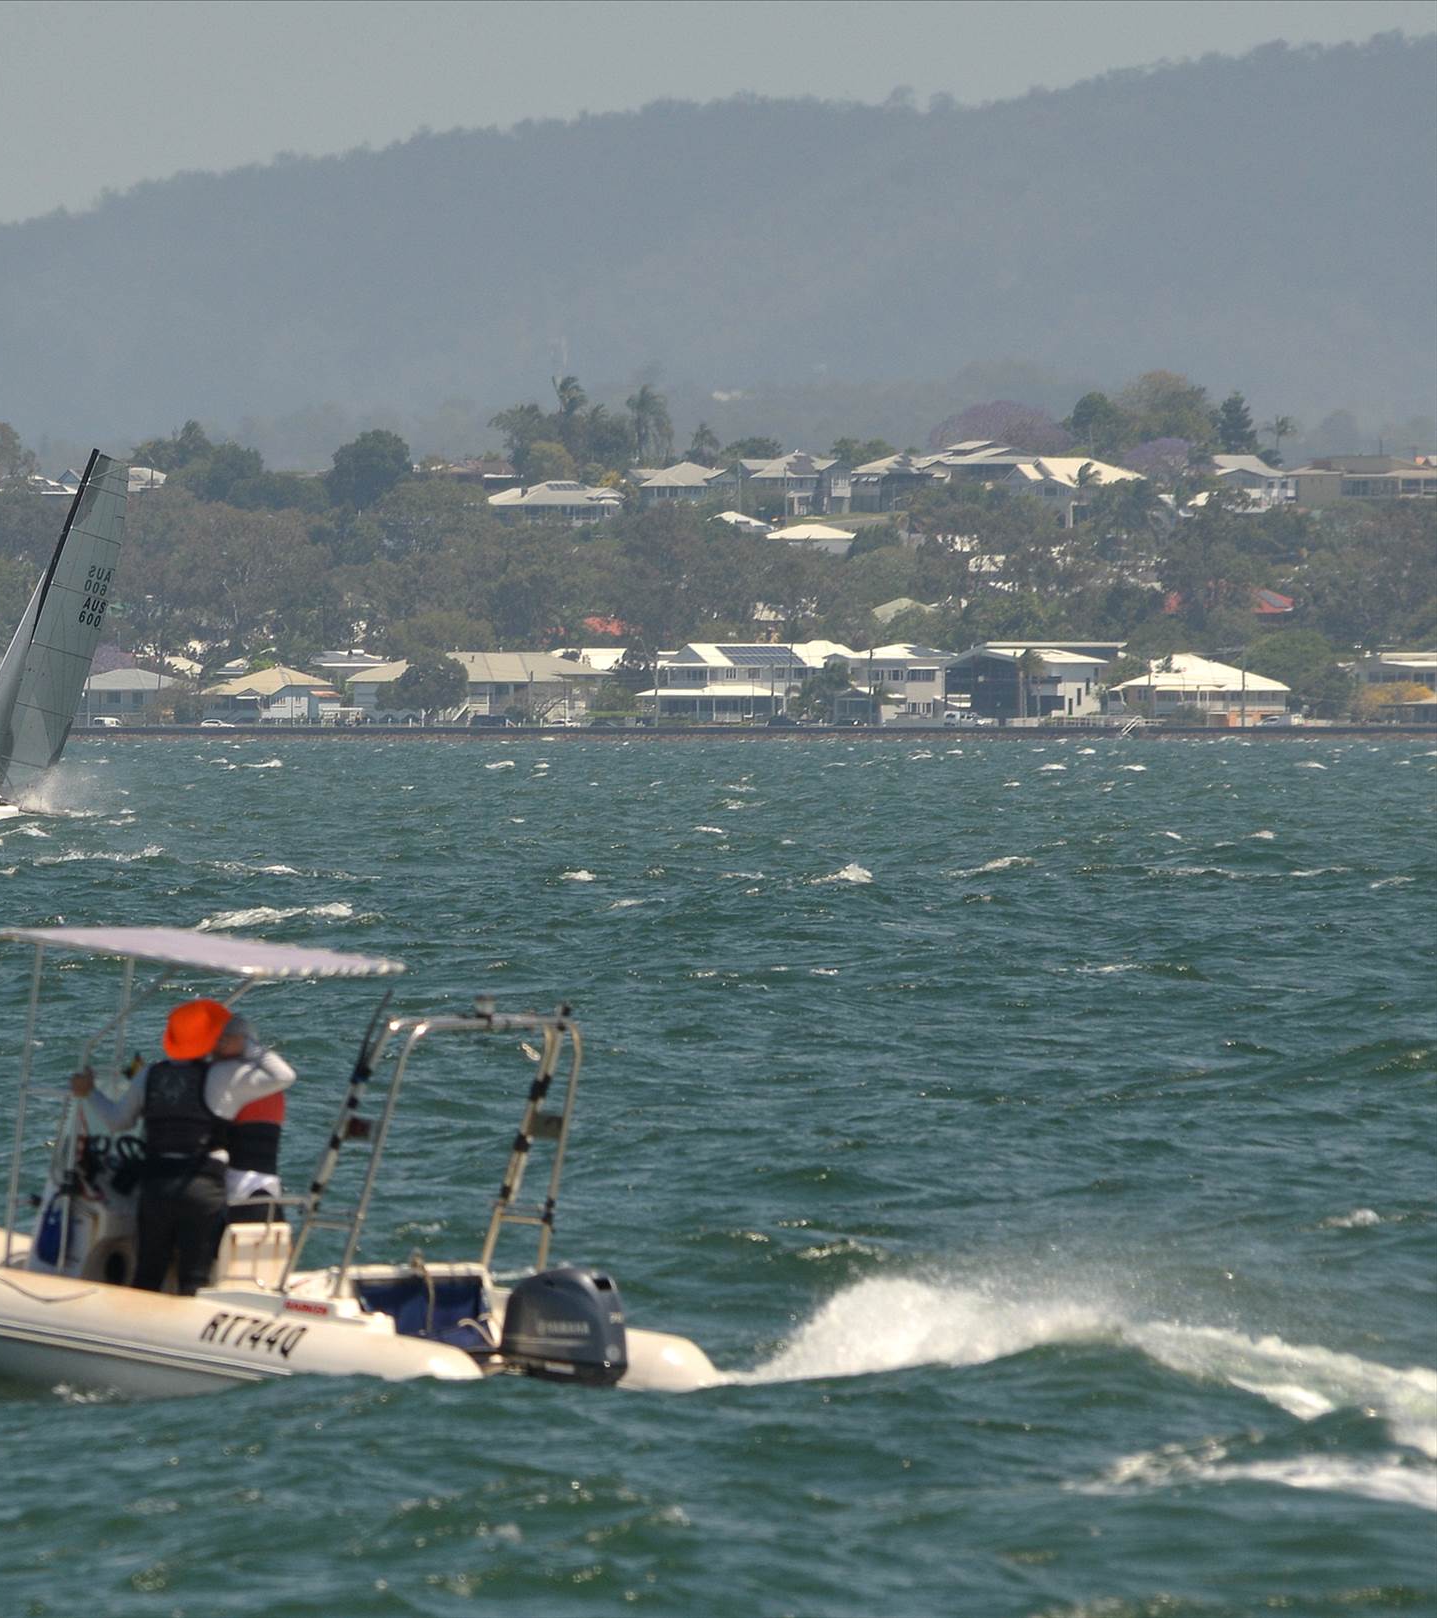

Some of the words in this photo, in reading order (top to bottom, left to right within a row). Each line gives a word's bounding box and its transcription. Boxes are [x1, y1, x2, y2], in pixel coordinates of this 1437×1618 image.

[83, 597, 107, 614] AUS
[78, 610, 102, 628] 600
[199, 1311, 308, 1359] RT744Q
